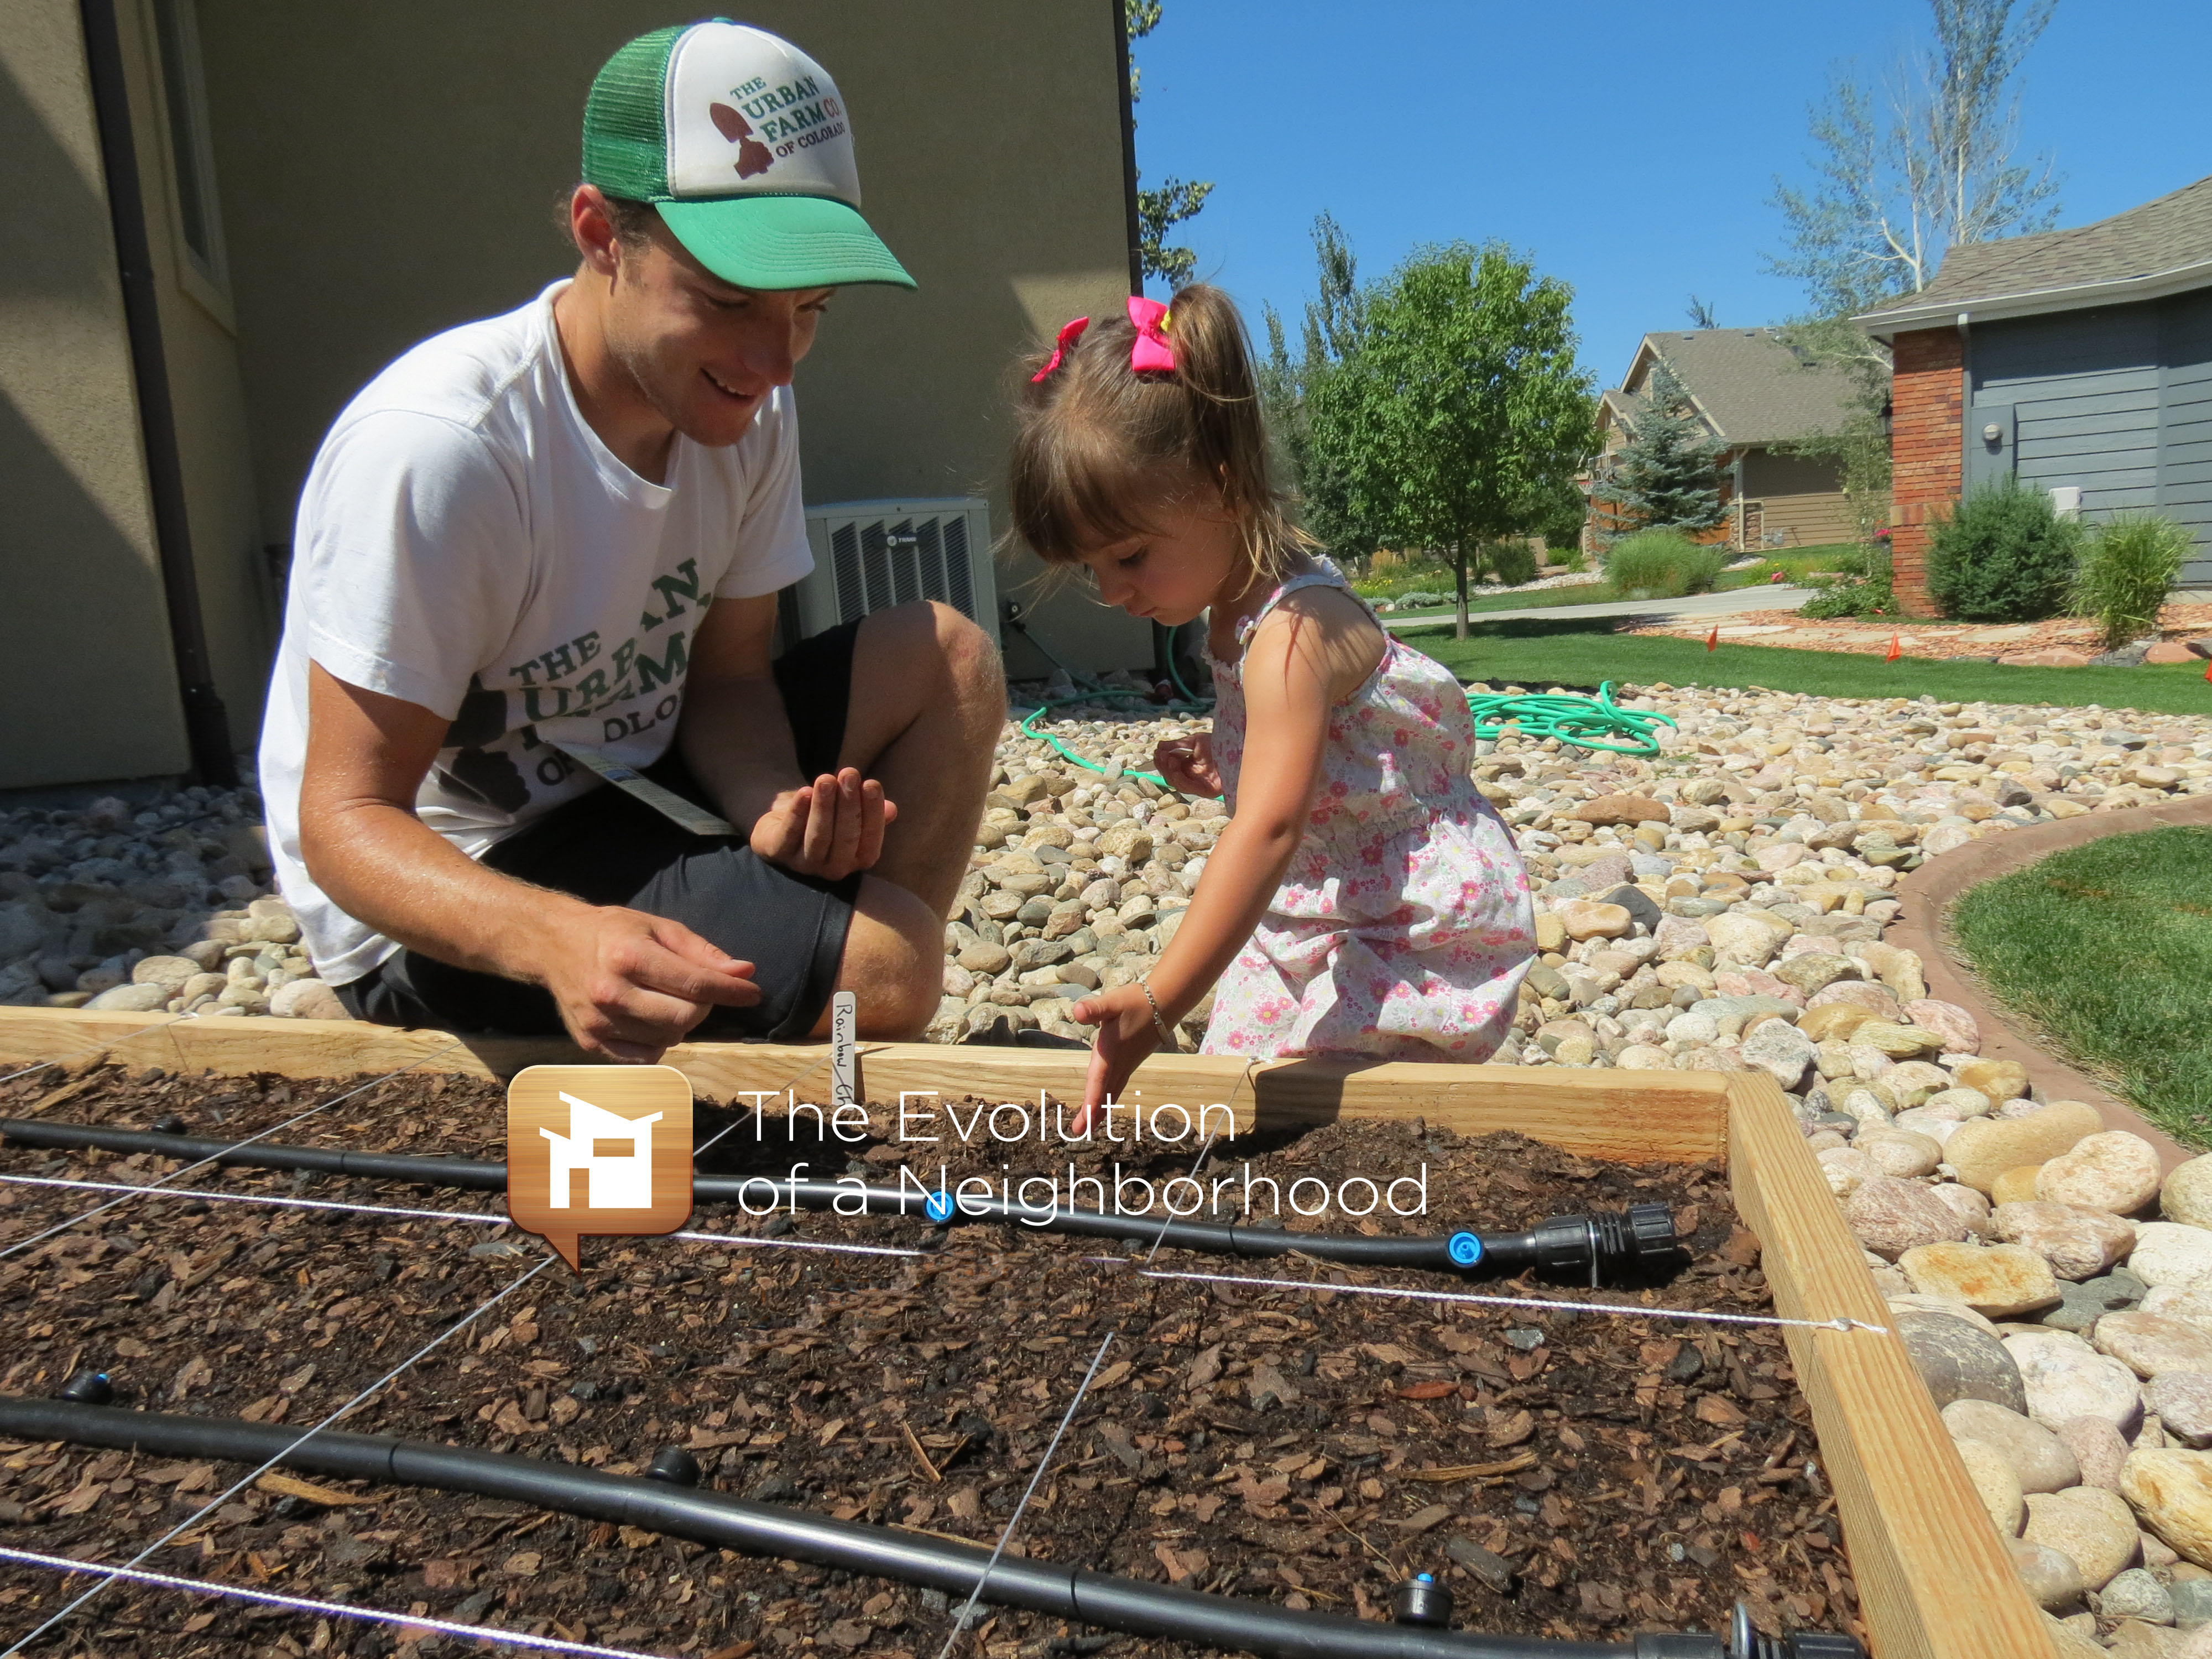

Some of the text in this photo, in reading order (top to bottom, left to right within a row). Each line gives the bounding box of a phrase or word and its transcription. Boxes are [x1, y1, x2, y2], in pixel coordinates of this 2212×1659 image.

[730, 77, 766, 100] THE
[741, 76, 820, 119] URBAN
[759, 102, 827, 143] FARM
[776, 121, 846, 158] OF COLORADO
[509, 630, 602, 686] THE
[836, 1004, 852, 1067] Rainbow
